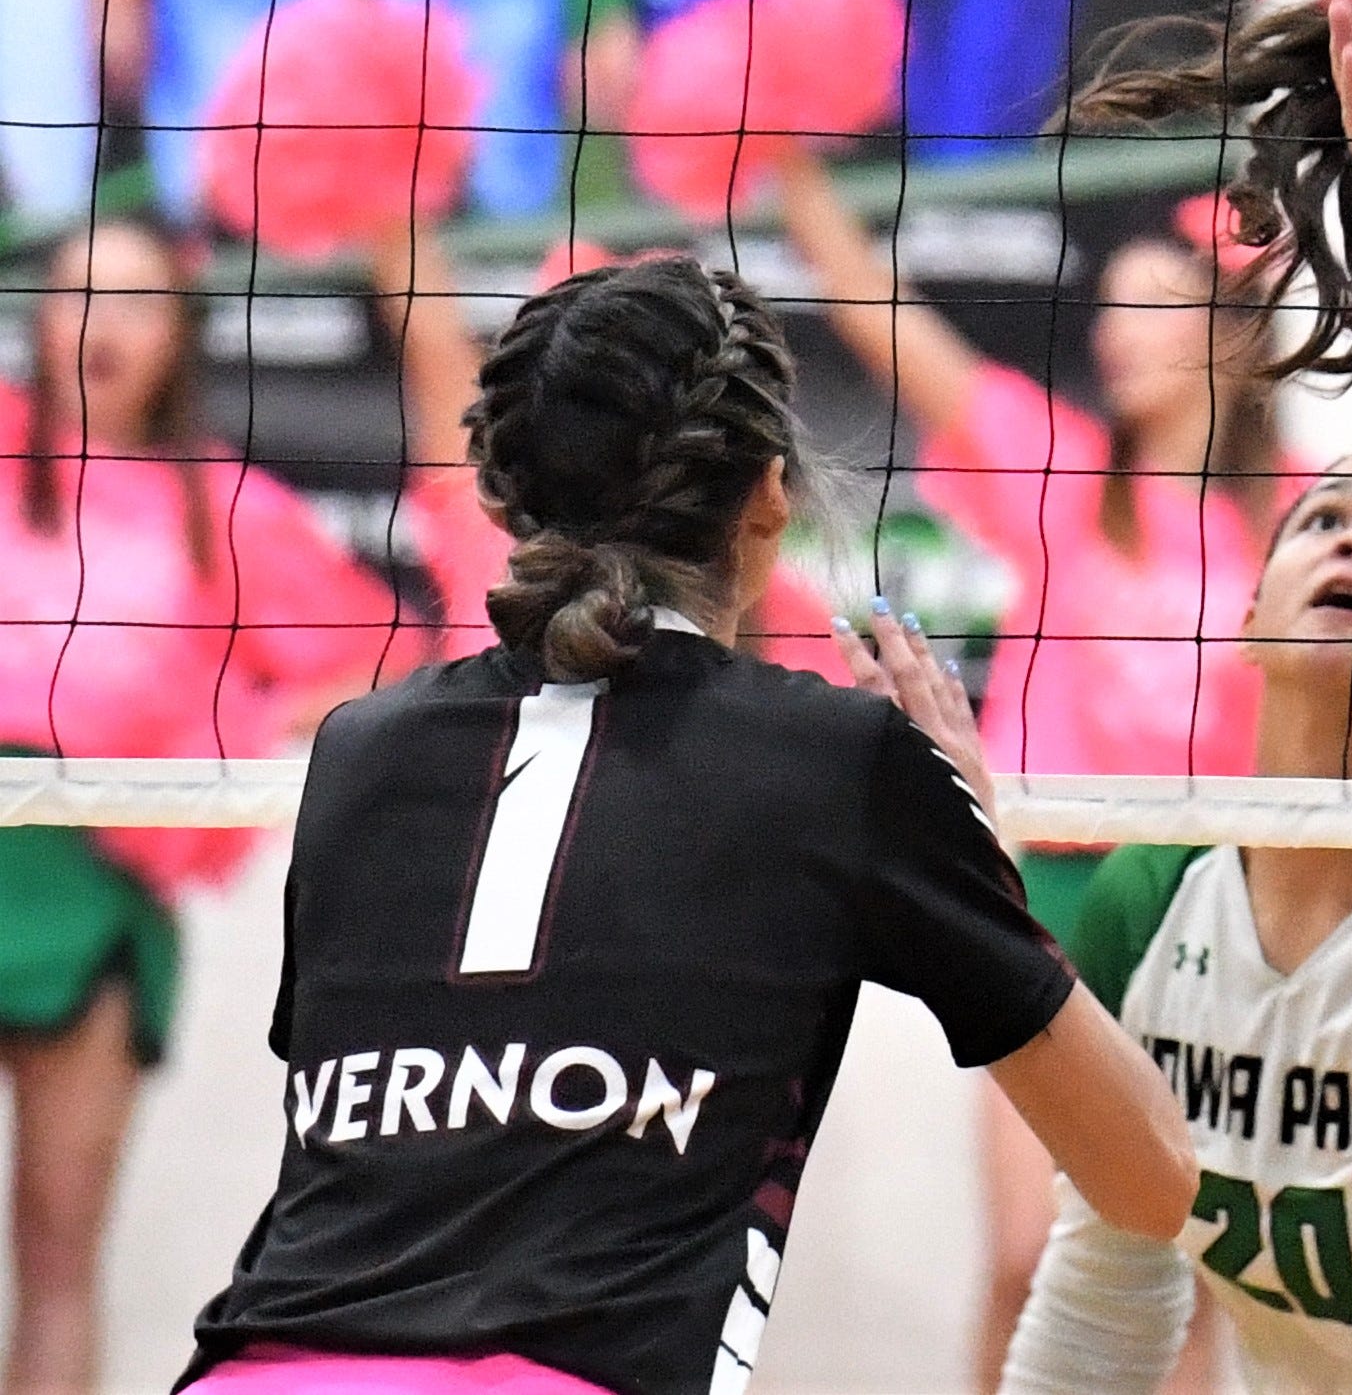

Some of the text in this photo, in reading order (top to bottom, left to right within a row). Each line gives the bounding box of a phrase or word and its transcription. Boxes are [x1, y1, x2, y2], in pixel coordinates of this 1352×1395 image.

[458, 678, 610, 975] 1
[293, 1042, 717, 1156] VERNON
[1143, 1035, 1263, 1141] OWA
